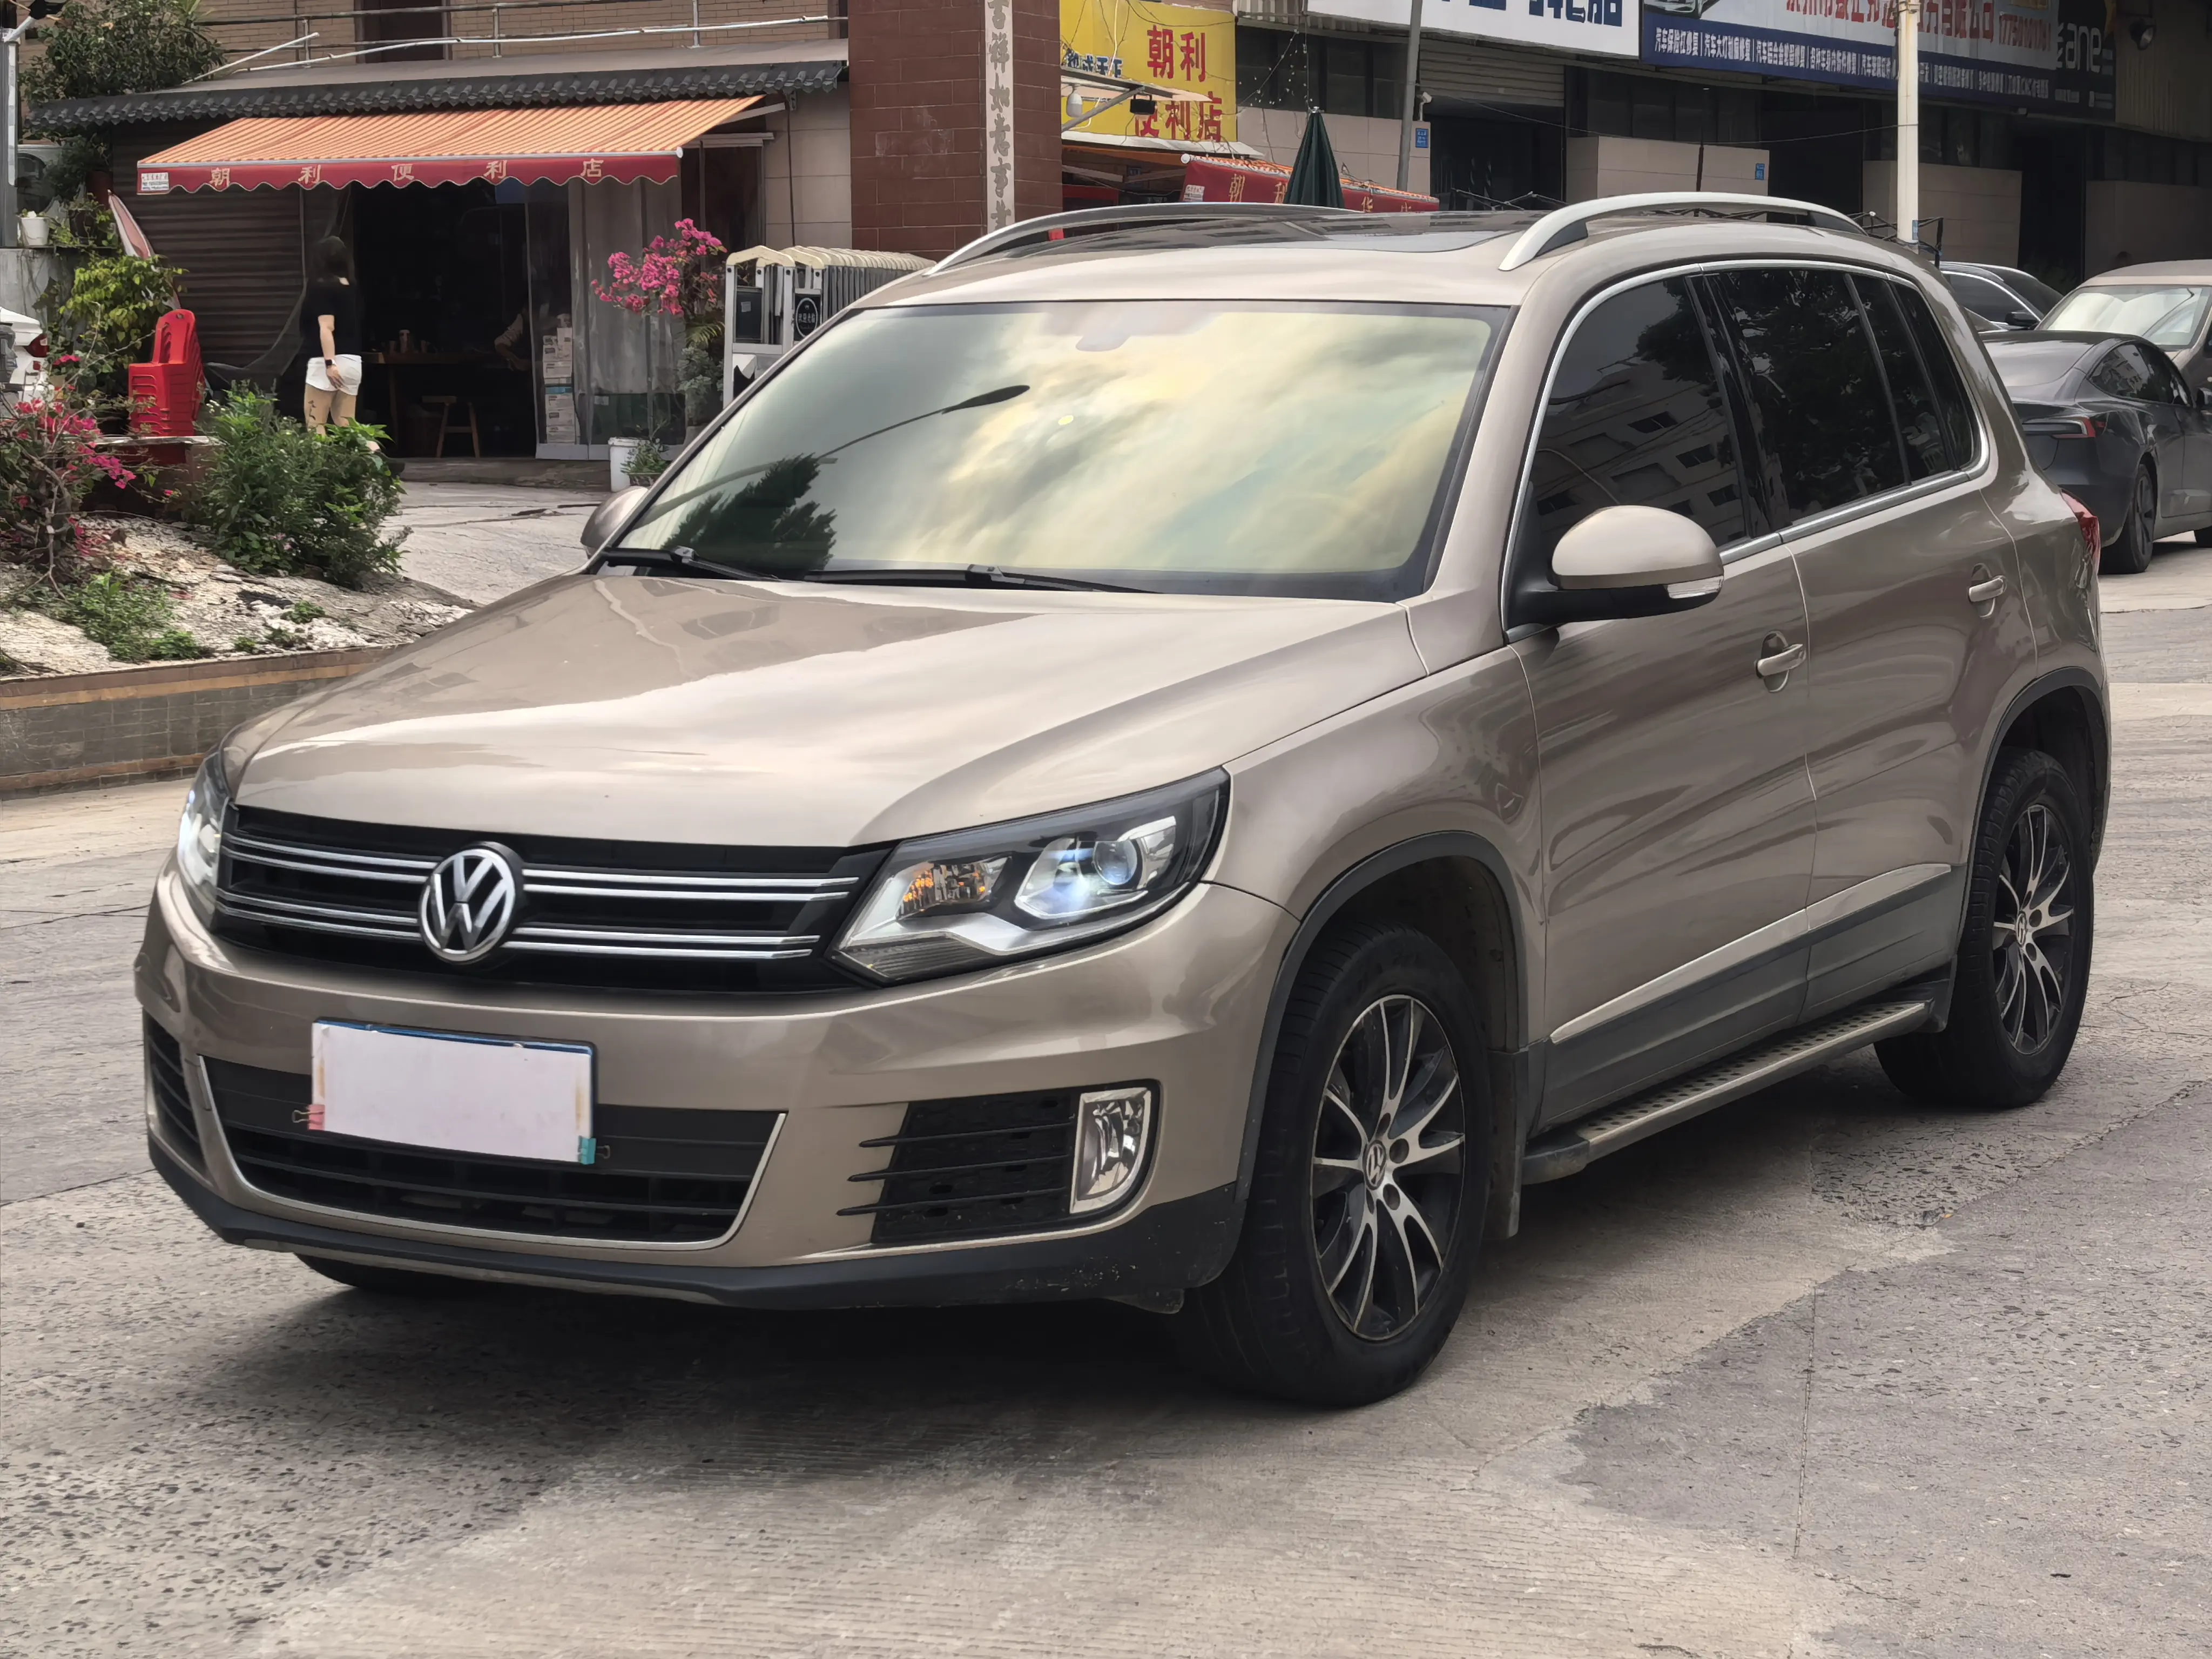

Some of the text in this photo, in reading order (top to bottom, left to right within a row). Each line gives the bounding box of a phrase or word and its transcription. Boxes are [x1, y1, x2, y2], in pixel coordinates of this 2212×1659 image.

[1147, 24, 1205, 83] 朝利
[210, 158, 604, 187] 朝利便利店
